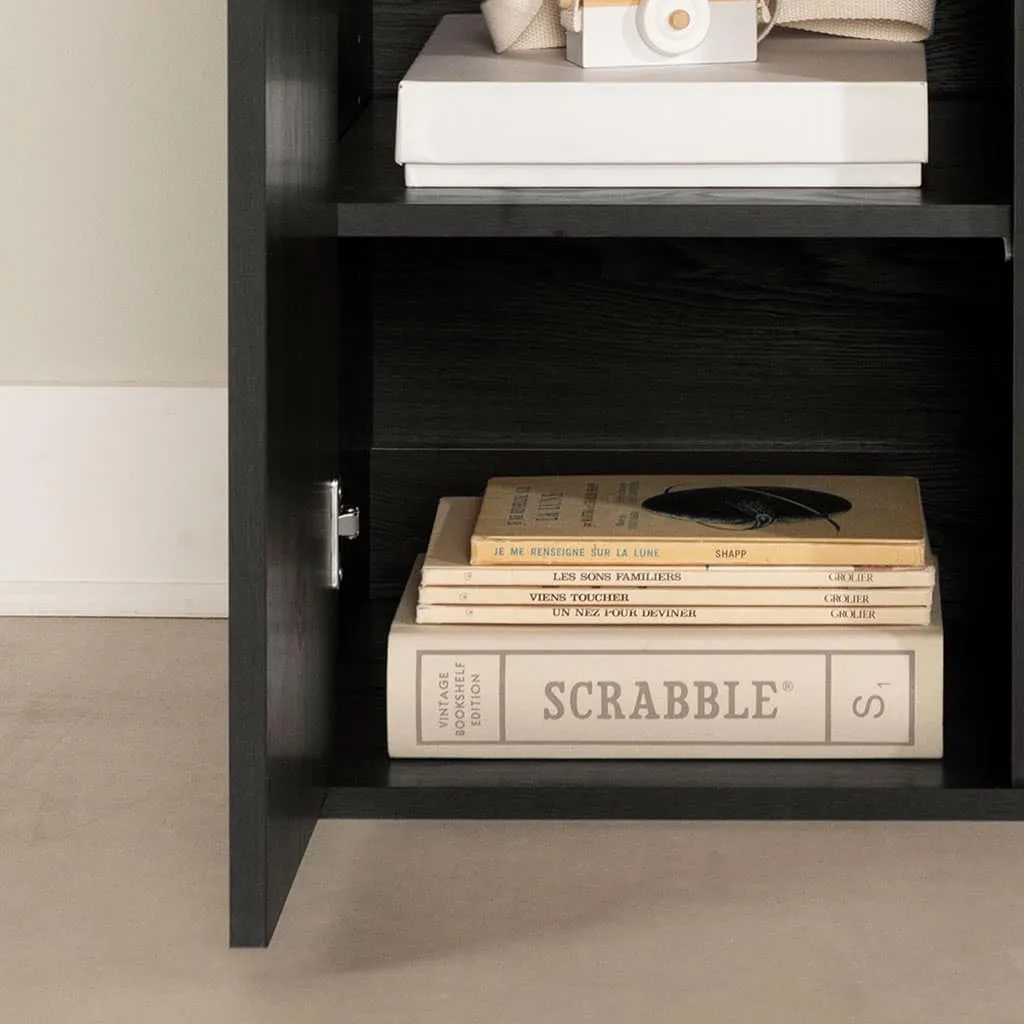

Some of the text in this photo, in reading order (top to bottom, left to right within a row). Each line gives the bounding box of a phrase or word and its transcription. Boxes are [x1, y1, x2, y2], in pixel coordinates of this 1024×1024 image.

[493, 547, 661, 558] JE ME RENSEIGNE SUR LA LUNE
[715, 549, 748, 559] SHAPP
[553, 572, 682, 582] LES SONS FAMILIERS
[828, 572, 874, 583] GROLIER
[529, 593, 630, 602] VIENS TOUCHER
[824, 593, 870, 604] GROLIER
[552, 608, 697, 618] UN NEZ POUR DEVINER
[830, 609, 876, 619] GROLIER
[438, 671, 449, 729] VINTAGE
[454, 661, 466, 737] BOOKSHELF
[470, 673, 481, 727] EDITION
